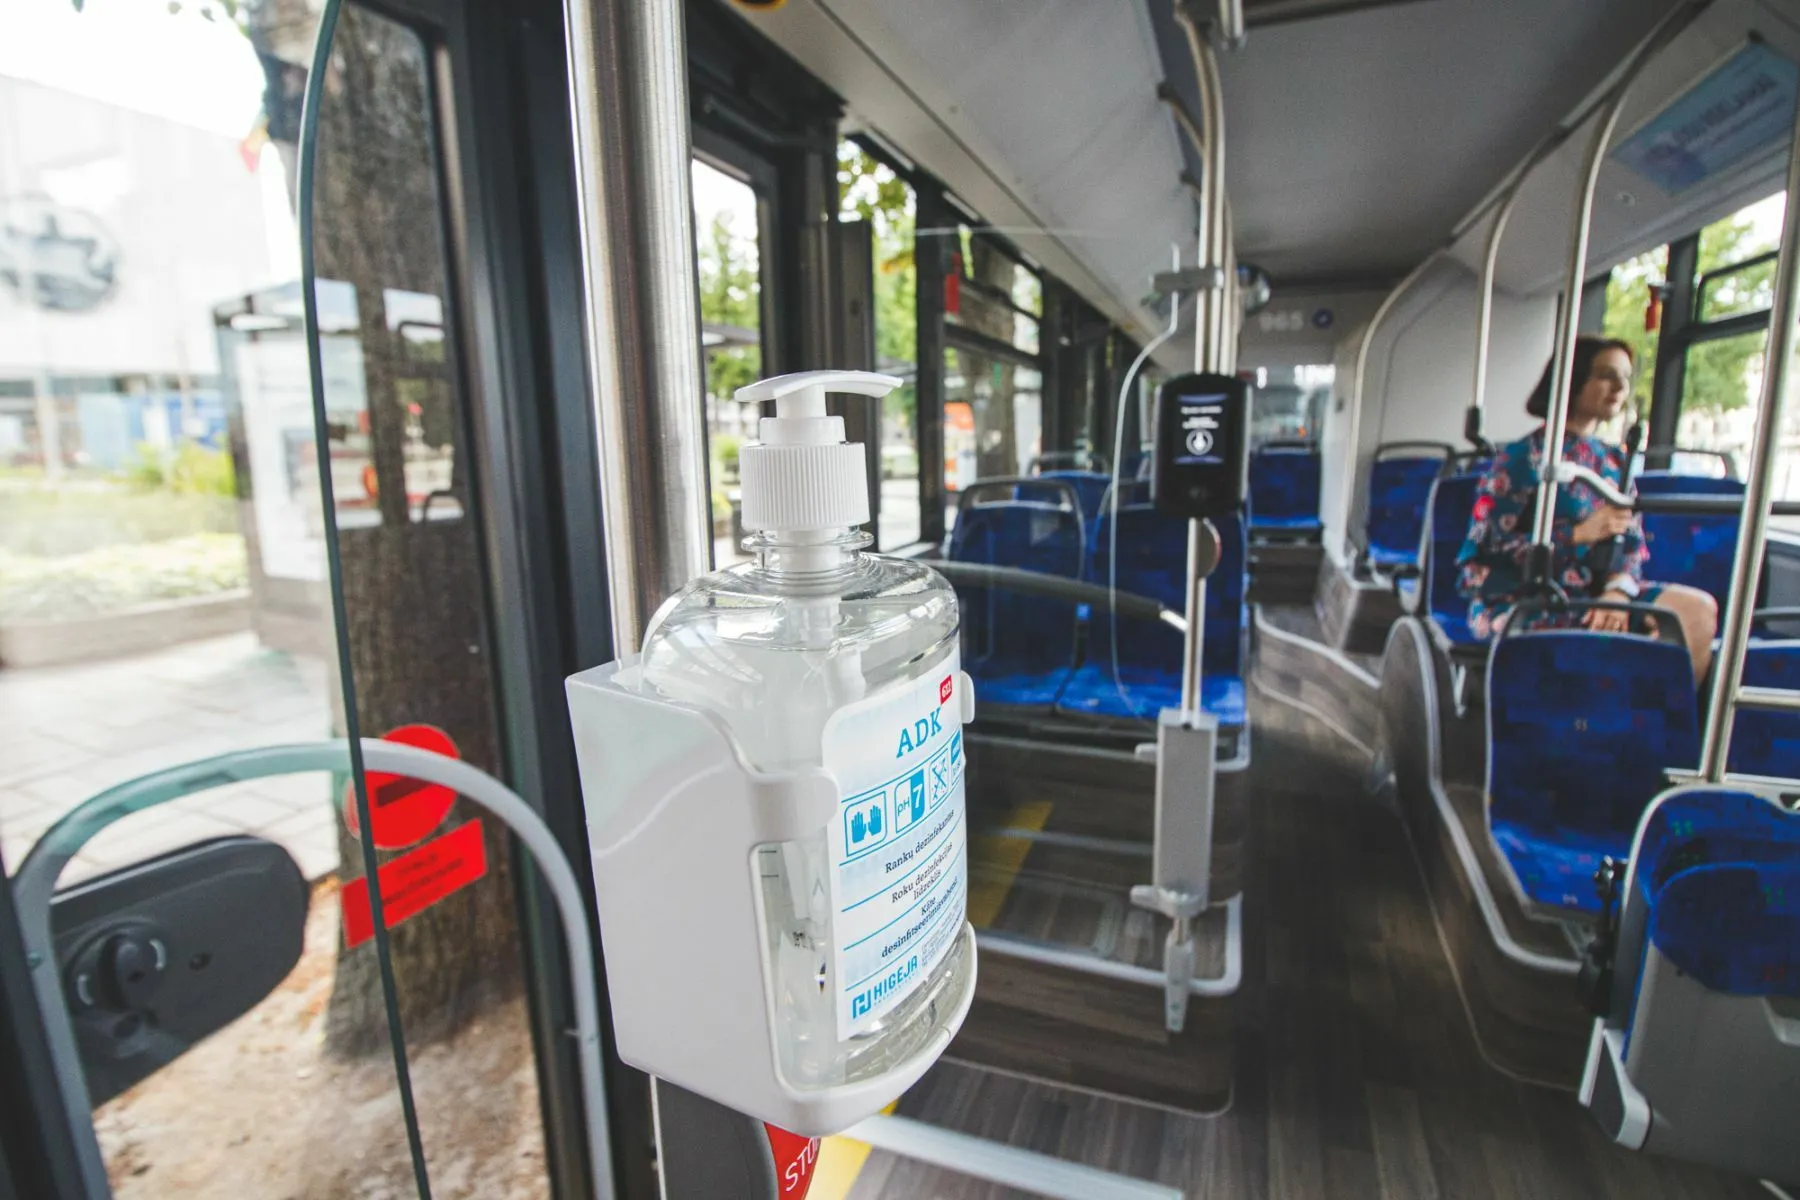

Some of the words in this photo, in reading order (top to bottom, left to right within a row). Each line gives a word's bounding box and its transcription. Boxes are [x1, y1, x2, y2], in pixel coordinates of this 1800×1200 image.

[896, 705, 943, 759] ADK
[897, 798, 910, 817] pH
[912, 783, 923, 809] 7
[891, 882, 914, 903] Roku
[874, 955, 918, 1000] HIGEJA
